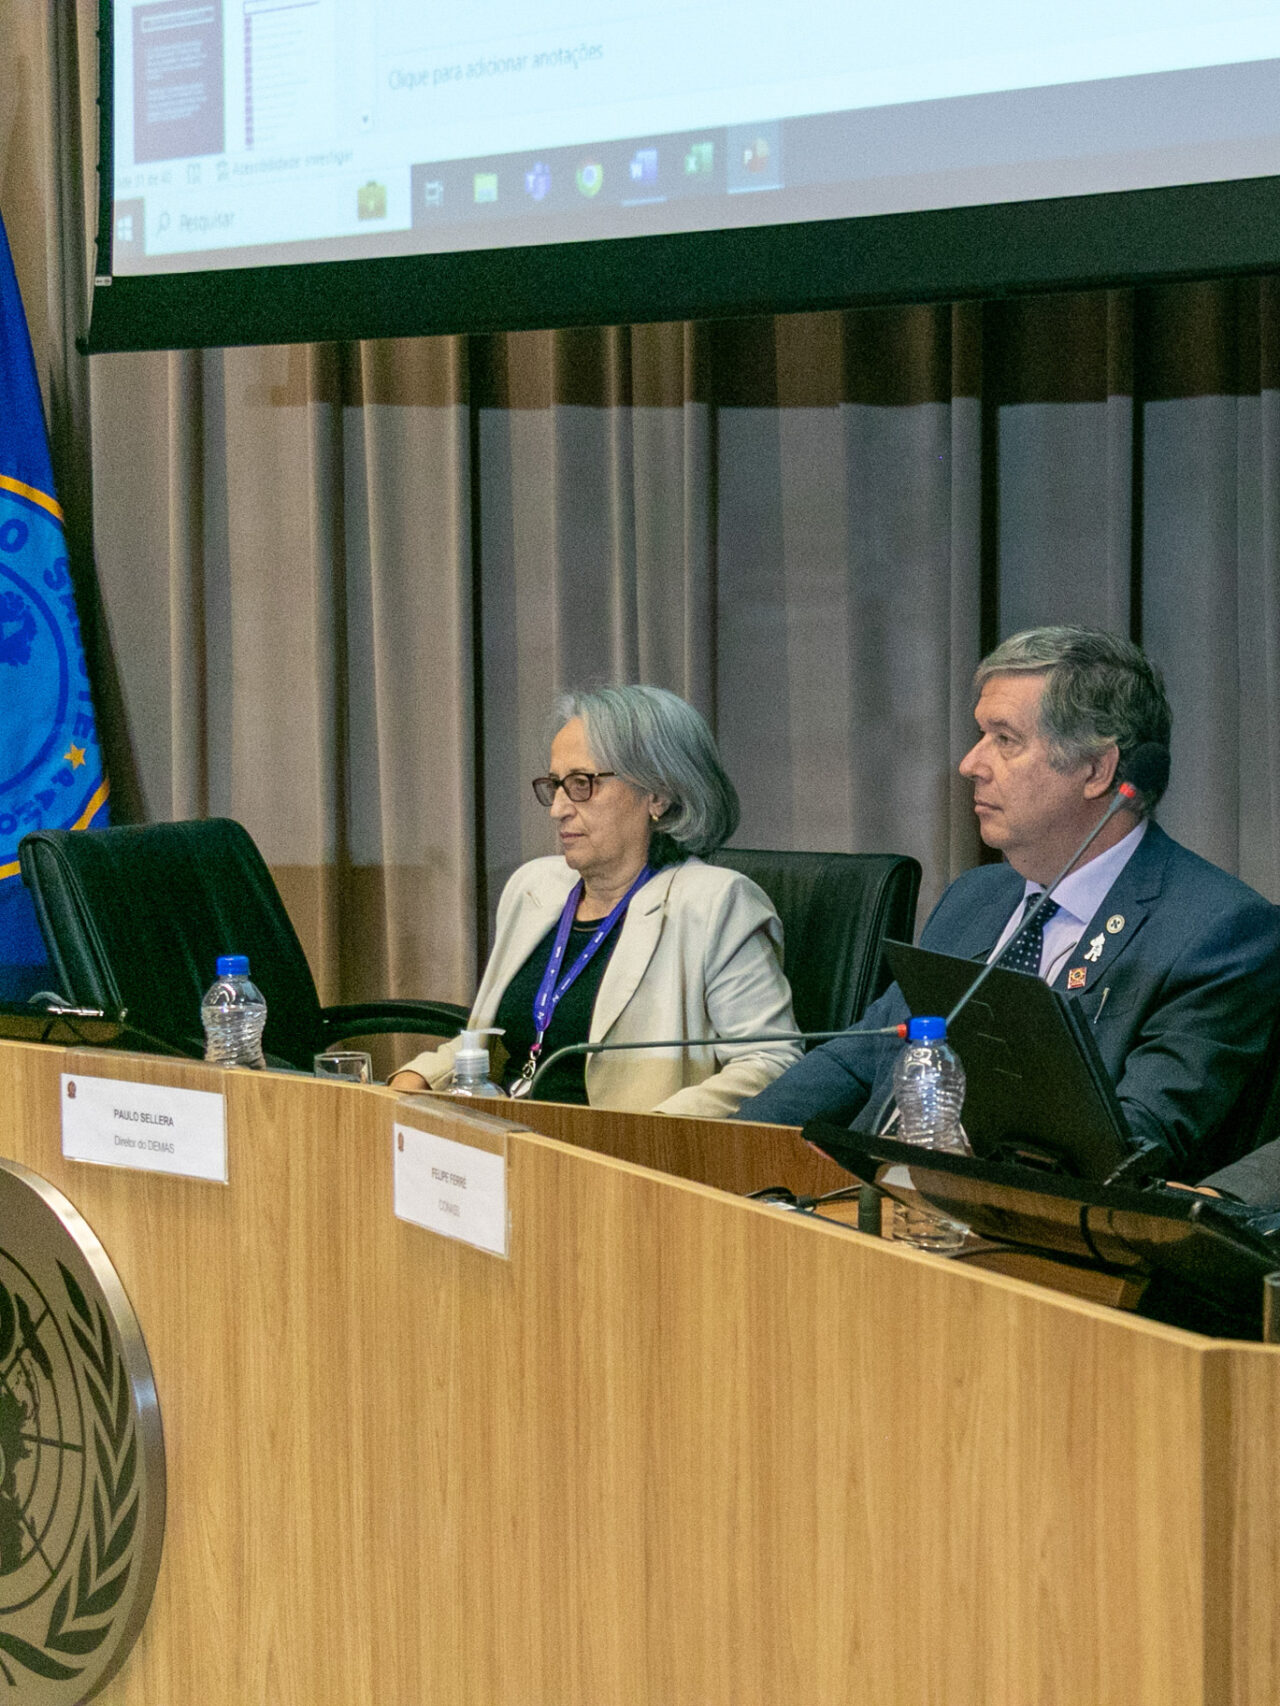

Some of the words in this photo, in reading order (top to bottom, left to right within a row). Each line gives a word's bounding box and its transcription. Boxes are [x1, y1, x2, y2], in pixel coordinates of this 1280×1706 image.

[388, 67, 428, 91] Clique
[432, 65, 463, 86] para
[465, 54, 529, 80] adicionar
[532, 42, 604, 70] anotações
[114, 1109, 138, 1122] PAULO
[140, 1112, 174, 1127] SELLERA
[114, 1135, 136, 1148] Diretor
